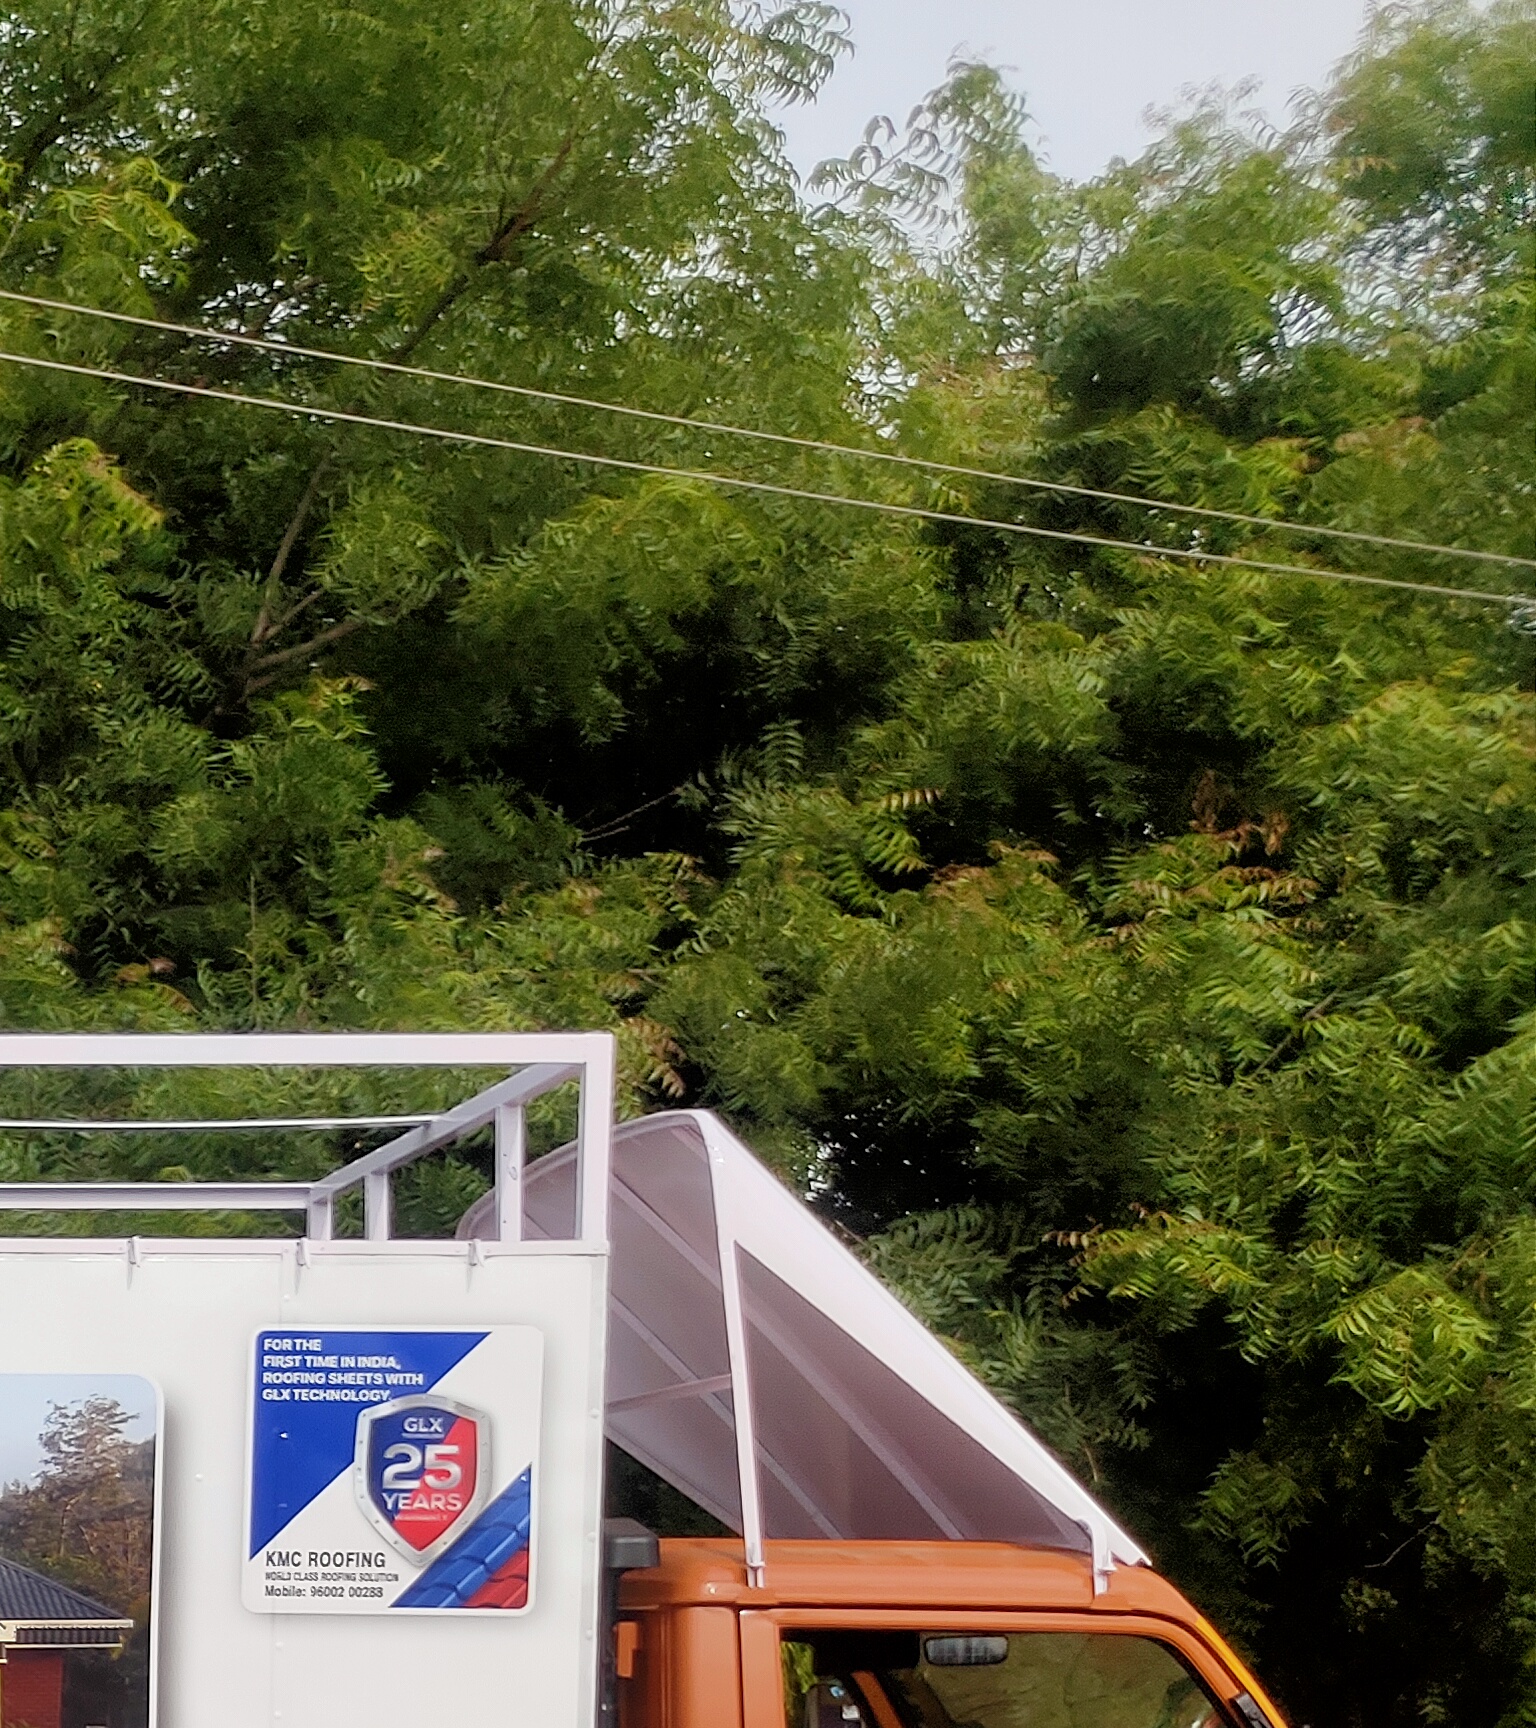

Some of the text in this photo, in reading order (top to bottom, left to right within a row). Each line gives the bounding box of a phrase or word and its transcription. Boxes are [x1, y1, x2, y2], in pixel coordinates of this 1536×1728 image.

[263, 1338, 322, 1351] FOR THE
[262, 1355, 302, 1368] FIRST
[304, 1356, 339, 1368] TIME
[340, 1356, 356, 1368] IN
[262, 1372, 424, 1385] ROOFING SHEETS WITH
[262, 1389, 291, 1401] GLX
[403, 1417, 443, 1432] GLX
[382, 1443, 462, 1490] 25
[381, 1492, 463, 1511] YEARS
[266, 1551, 386, 1568] KMC ROOFING
[293, 1572, 319, 1581] CLASS
[320, 1572, 357, 1582] ROOFING
[265, 1585, 306, 1597] Mobile:
[309, 1586, 345, 1597] 96002
